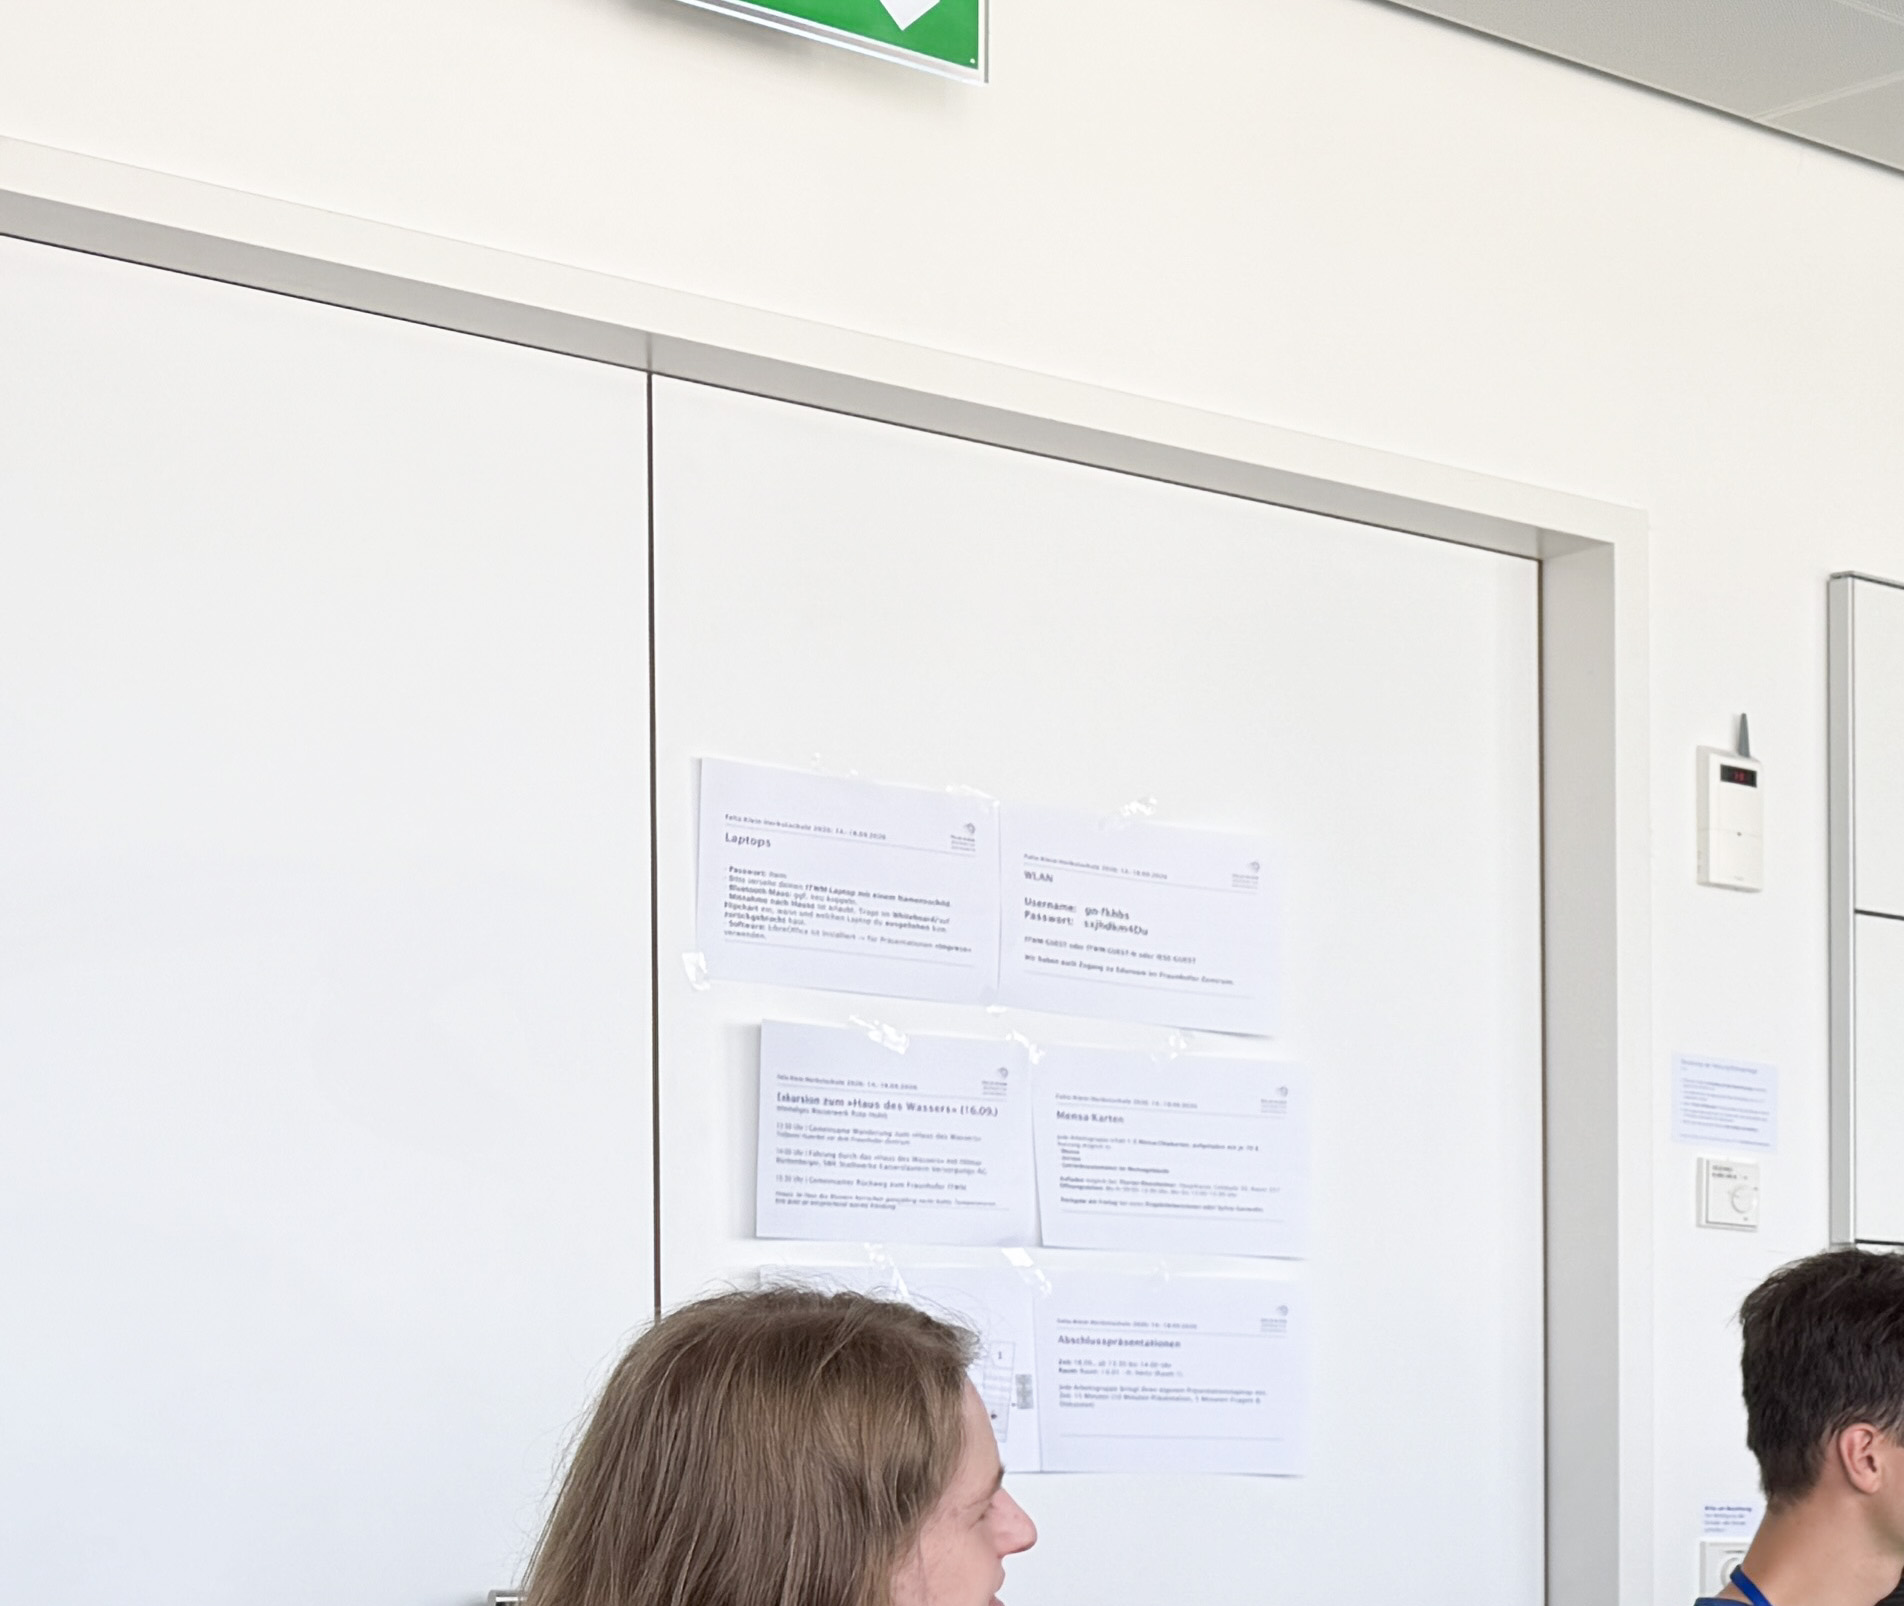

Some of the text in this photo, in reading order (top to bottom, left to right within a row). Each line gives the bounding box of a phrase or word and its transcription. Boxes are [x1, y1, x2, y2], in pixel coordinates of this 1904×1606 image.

[725, 832, 771, 848] Laptops
[1024, 870, 1055, 883] WLAN
[1024, 896, 1077, 913] Username:
[1024, 910, 1075, 926] Passwort:
